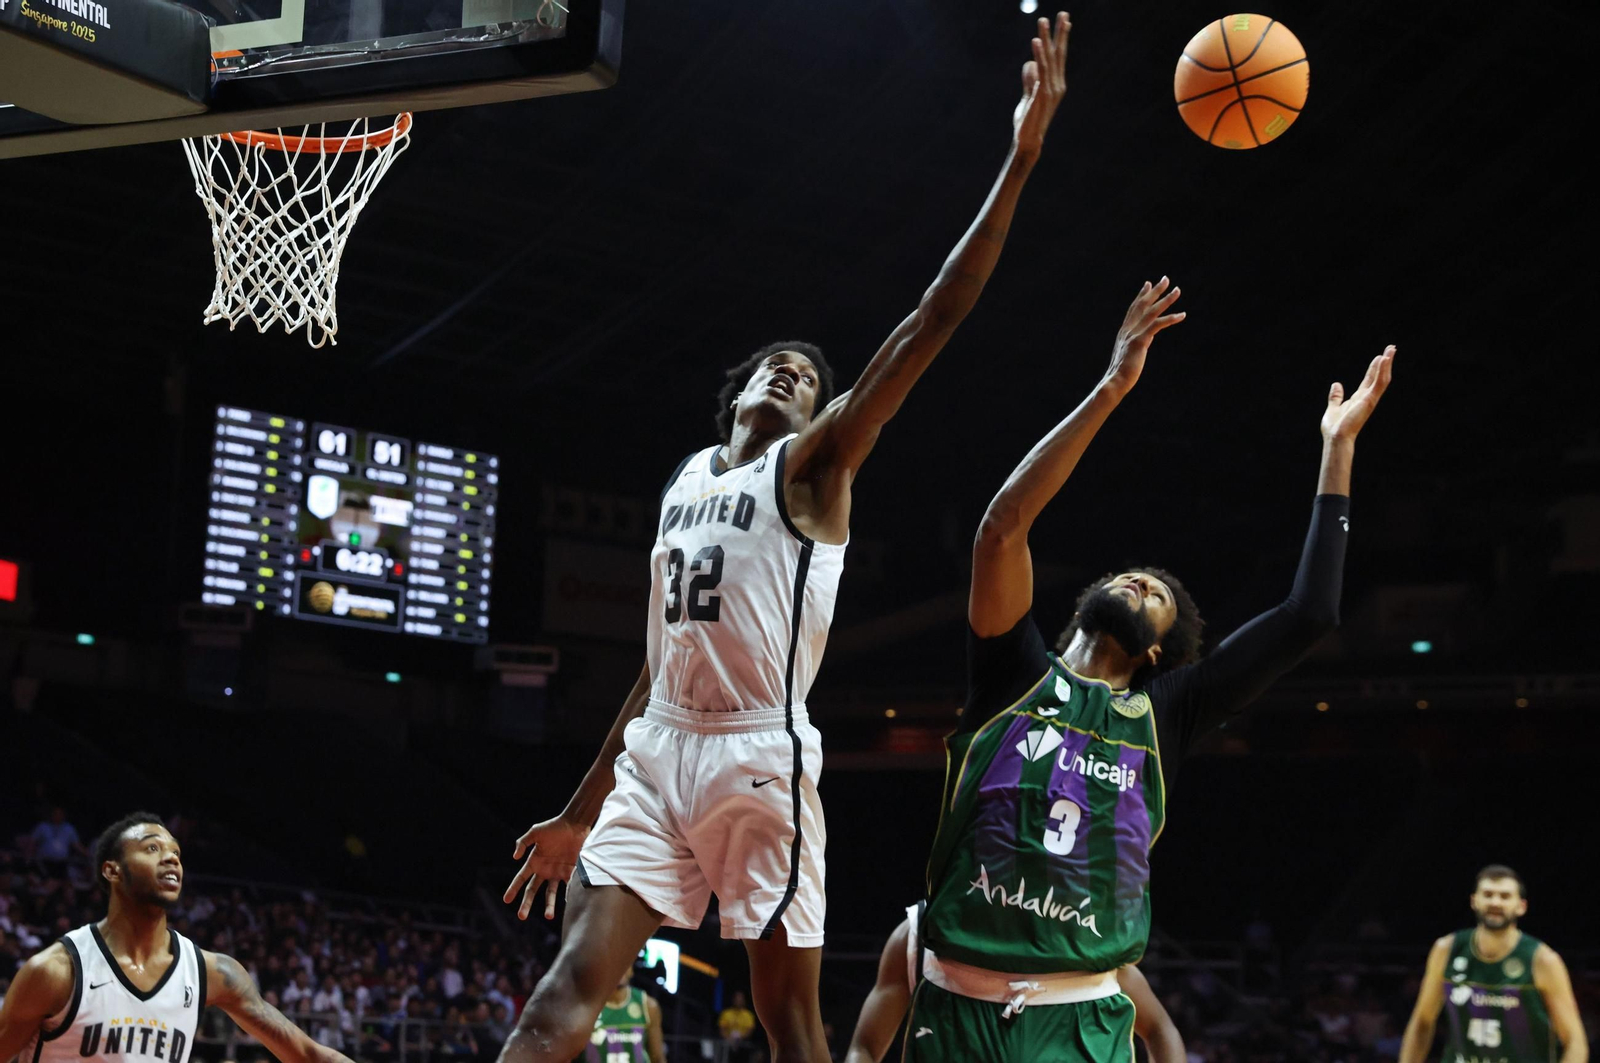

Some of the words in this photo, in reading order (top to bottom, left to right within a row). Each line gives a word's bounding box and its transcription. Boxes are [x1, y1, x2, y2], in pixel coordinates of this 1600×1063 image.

[20, 0, 68, 32] Singapore
[70, 21, 96, 42] 2025
[662, 491, 756, 540] UNITED
[664, 545, 725, 624] 32
[1058, 747, 1137, 792] Unicaja
[1043, 799, 1081, 856] 3
[966, 864, 1103, 938] Andalucía
[80, 1022, 186, 1063] UNITED
[1467, 1018, 1502, 1047] 45
